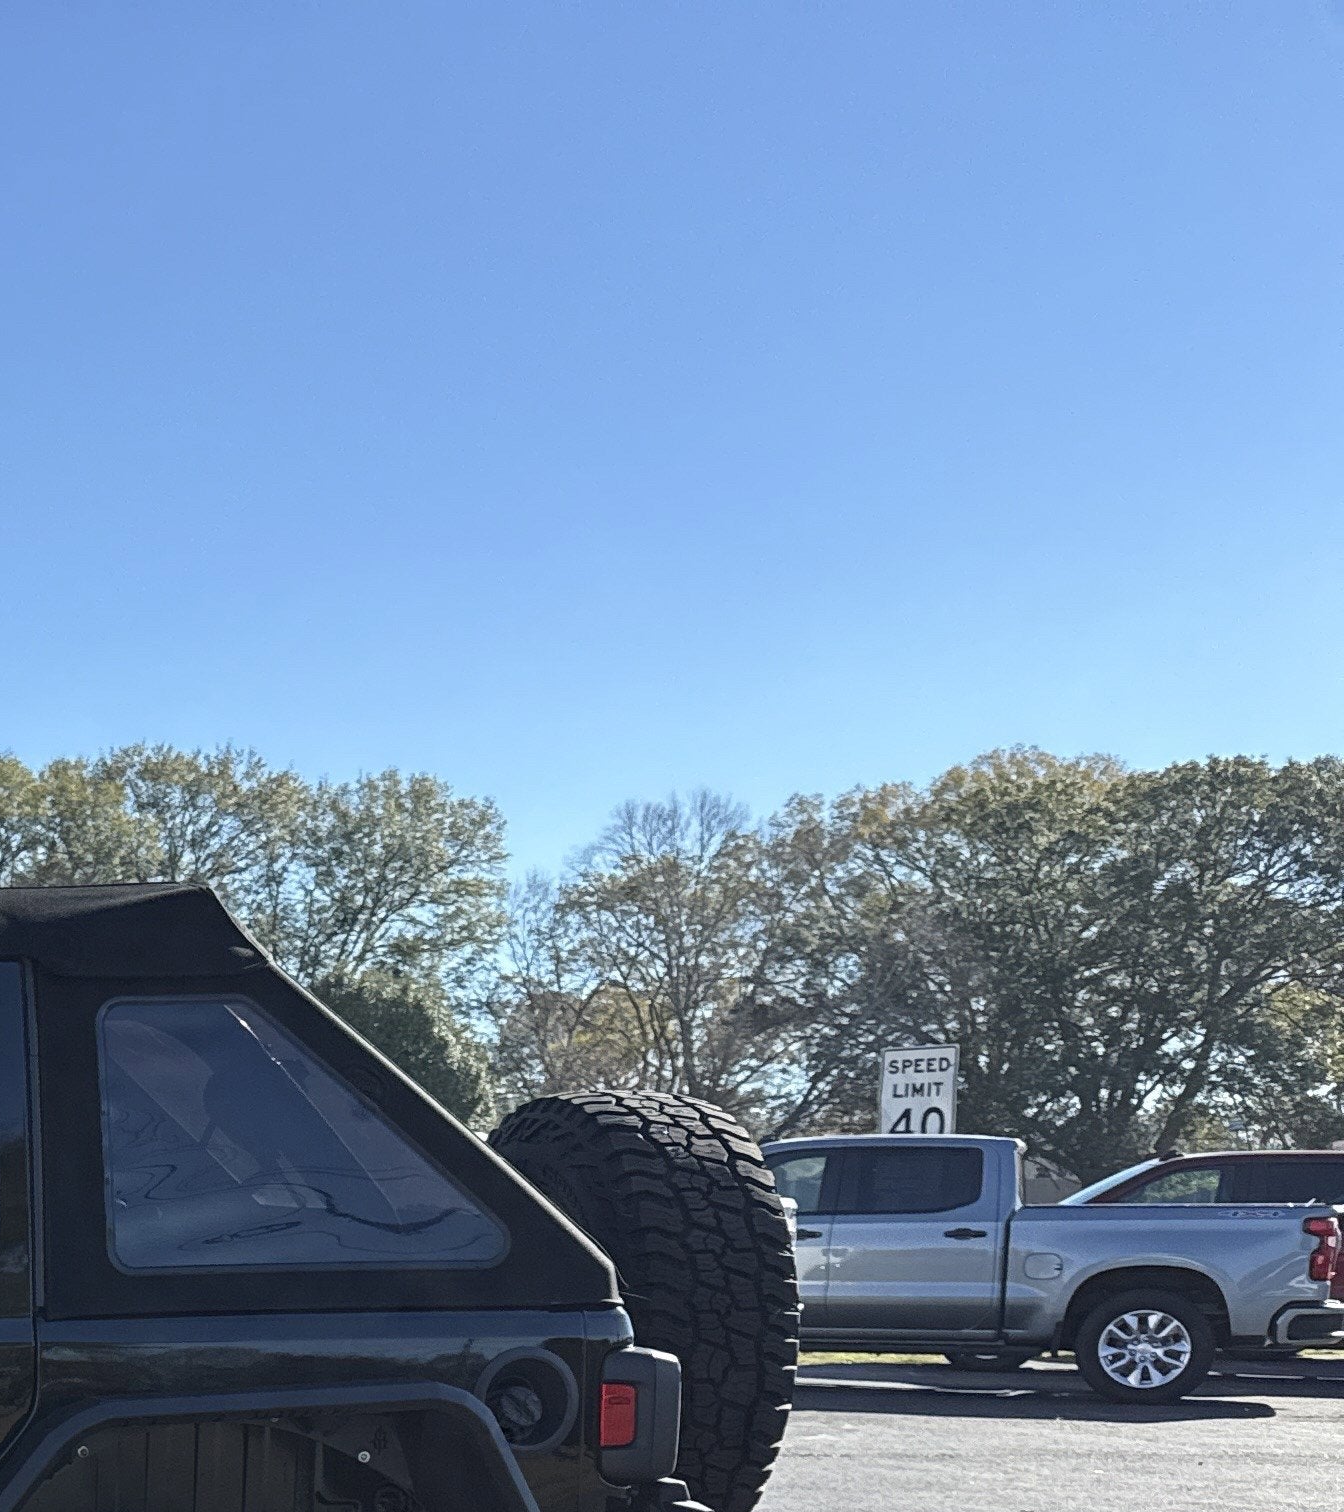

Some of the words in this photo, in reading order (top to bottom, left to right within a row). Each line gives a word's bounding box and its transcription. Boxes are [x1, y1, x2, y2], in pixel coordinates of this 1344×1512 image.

[888, 1057, 952, 1074] SPEED
[892, 1082, 944, 1098] LIMIT
[888, 1106, 946, 1134] 40
